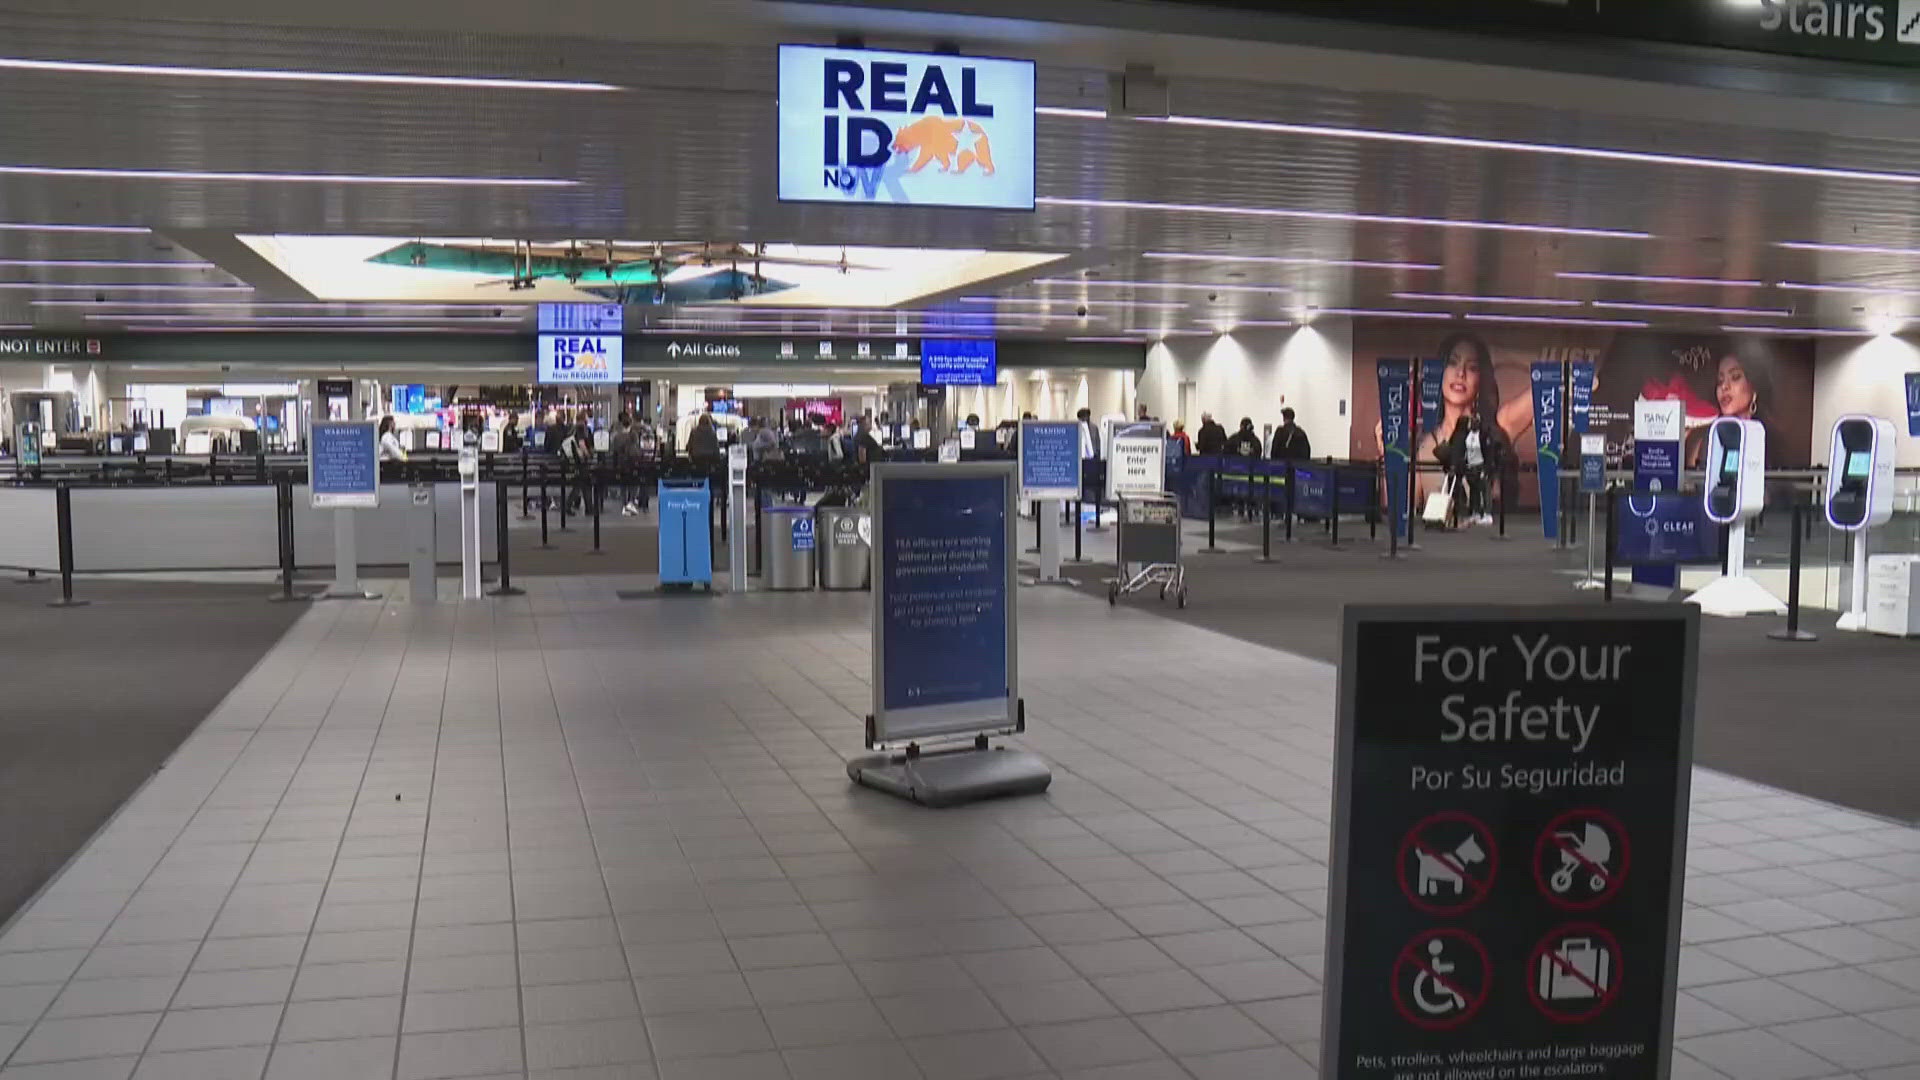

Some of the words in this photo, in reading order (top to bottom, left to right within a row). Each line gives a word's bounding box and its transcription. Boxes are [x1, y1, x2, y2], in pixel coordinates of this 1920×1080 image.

[823, 58, 994, 119] REAL
[823, 115, 894, 168] ID
[0, 340, 30, 354] NOT
[36, 340, 80, 354] ENTER
[554, 337, 607, 354] REAL
[682, 341, 701, 357] All
[704, 342, 741, 358] Gates
[554, 354, 575, 370] ID
[571, 371, 609, 379] REQUIRED
[1389, 383, 1402, 413] TSA
[1541, 386, 1555, 417] TSA
[324, 428, 361, 436] WARNING
[1033, 427, 1067, 435] WARNING
[1115, 444, 1159, 455] Passengers
[1126, 456, 1147, 465] Enter
[1127, 467, 1146, 476] Here
[1663, 522, 1694, 531] CLEAR
[912, 536, 944, 548] officers
[944, 537, 959, 547] are
[959, 535, 992, 547] working
[897, 550, 930, 561] without
[931, 552, 946, 563] pay
[948, 549, 975, 561] during
[976, 548, 989, 558] the
[895, 564, 947, 577] government
[1414, 634, 1498, 683] For
[1511, 634, 1632, 682] Your
[1439, 690, 1601, 753] Safety
[1411, 765, 1454, 791] Por
[1461, 763, 1492, 789] Su
[1500, 760, 1625, 793] Seguridad
[1356, 1054, 1386, 1069] Pets,
[1391, 1052, 1444, 1067] strollers,
[1448, 1046, 1523, 1064] wheelchairs
[1526, 1044, 1552, 1060] and
[1554, 1043, 1586, 1061] large
[1589, 1041, 1645, 1059] baggage
[1393, 1070, 1414, 1080] are
[1418, 1067, 1441, 1080] not
[1444, 1065, 1496, 1080] allowed
[1498, 1067, 1516, 1079] on
[1519, 1063, 1541, 1078] the
